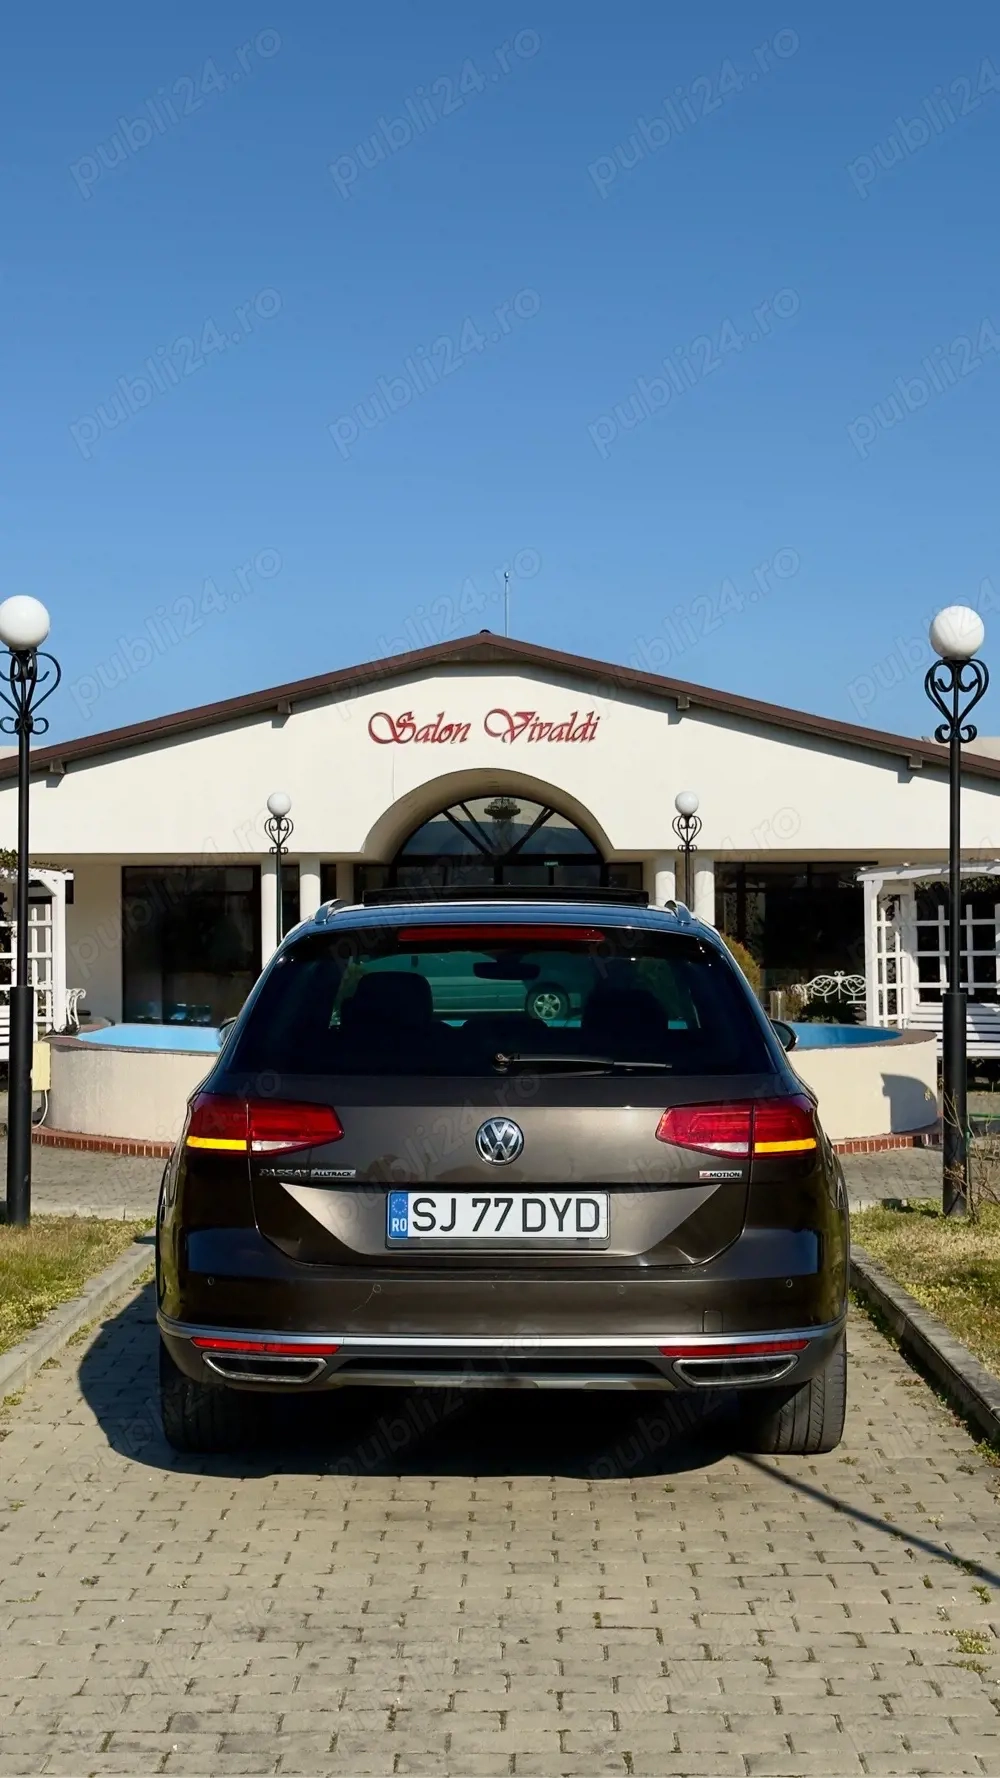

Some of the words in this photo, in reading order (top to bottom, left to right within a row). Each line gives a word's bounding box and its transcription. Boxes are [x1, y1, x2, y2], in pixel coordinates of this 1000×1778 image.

[368, 711, 472, 744] Salon
[484, 708, 601, 744] Vivaldi
[260, 1168, 309, 1177] PASSAT
[392, 1218, 407, 1232] RO
[412, 1198, 457, 1231] SJ
[472, 1198, 514, 1231] 77
[522, 1198, 600, 1232] DYD
